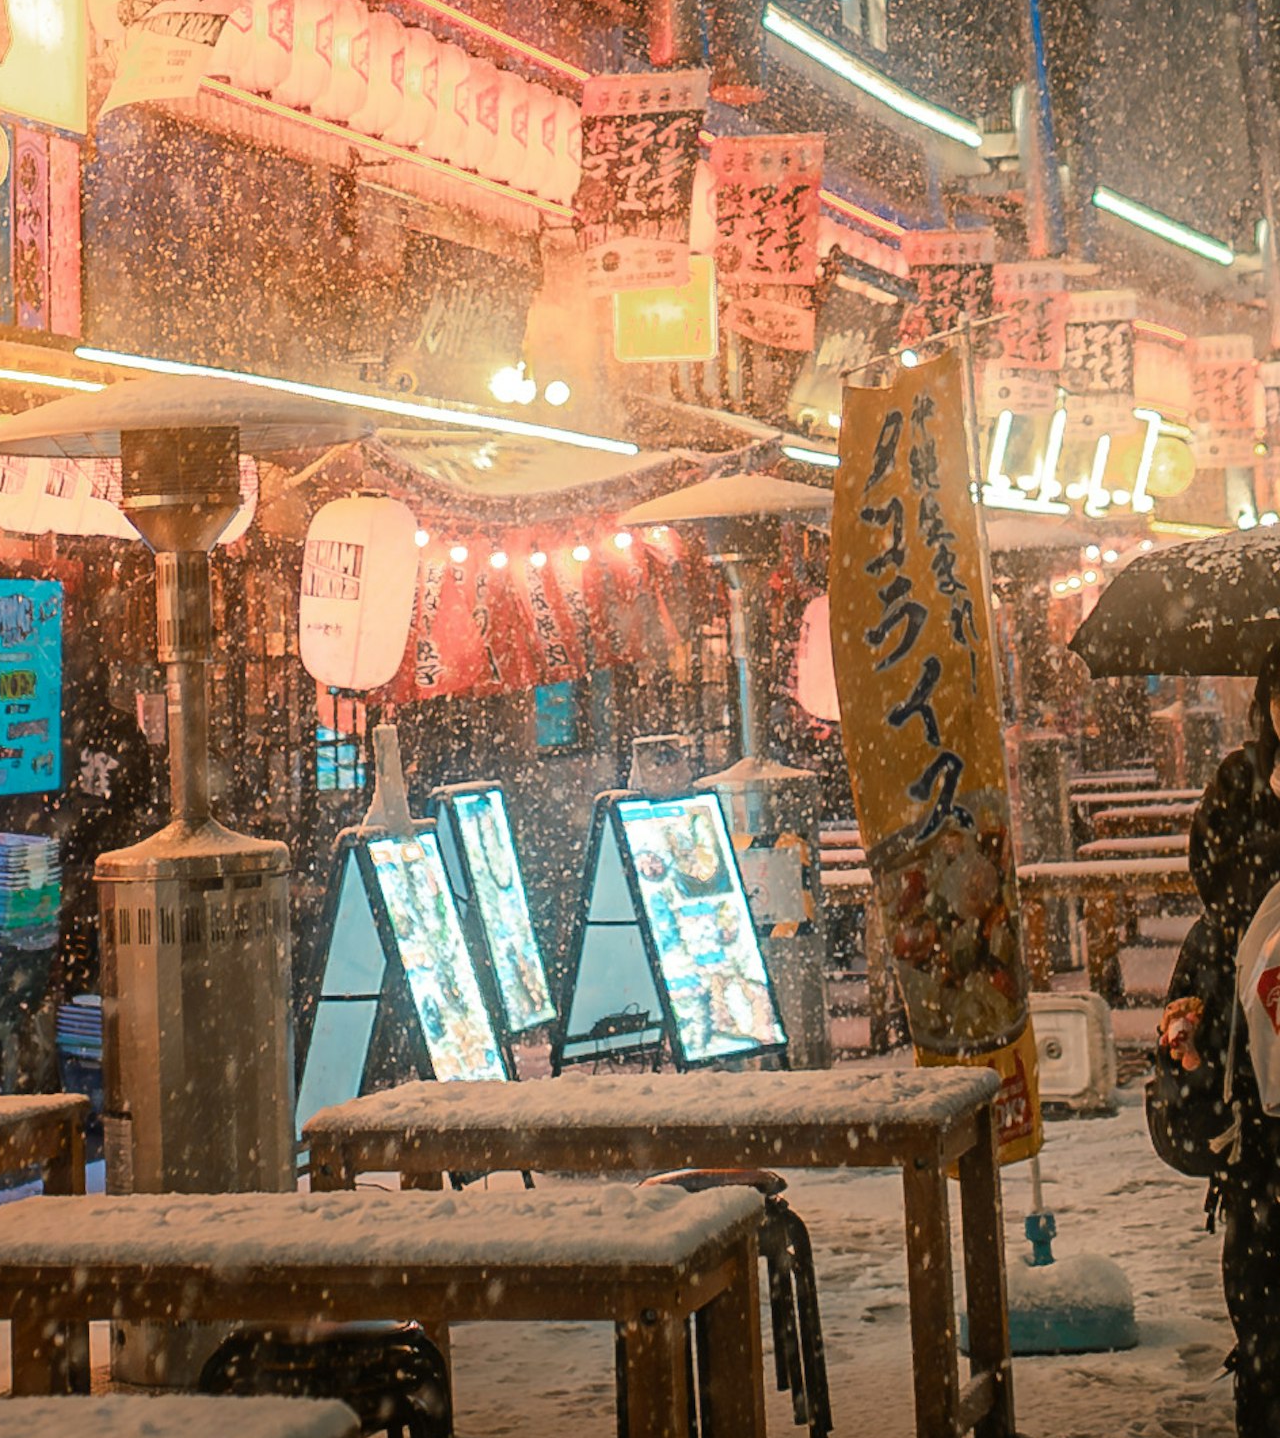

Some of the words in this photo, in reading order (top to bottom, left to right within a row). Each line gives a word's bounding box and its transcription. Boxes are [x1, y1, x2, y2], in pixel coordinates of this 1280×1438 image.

[860, 410, 973, 842] タコライス
